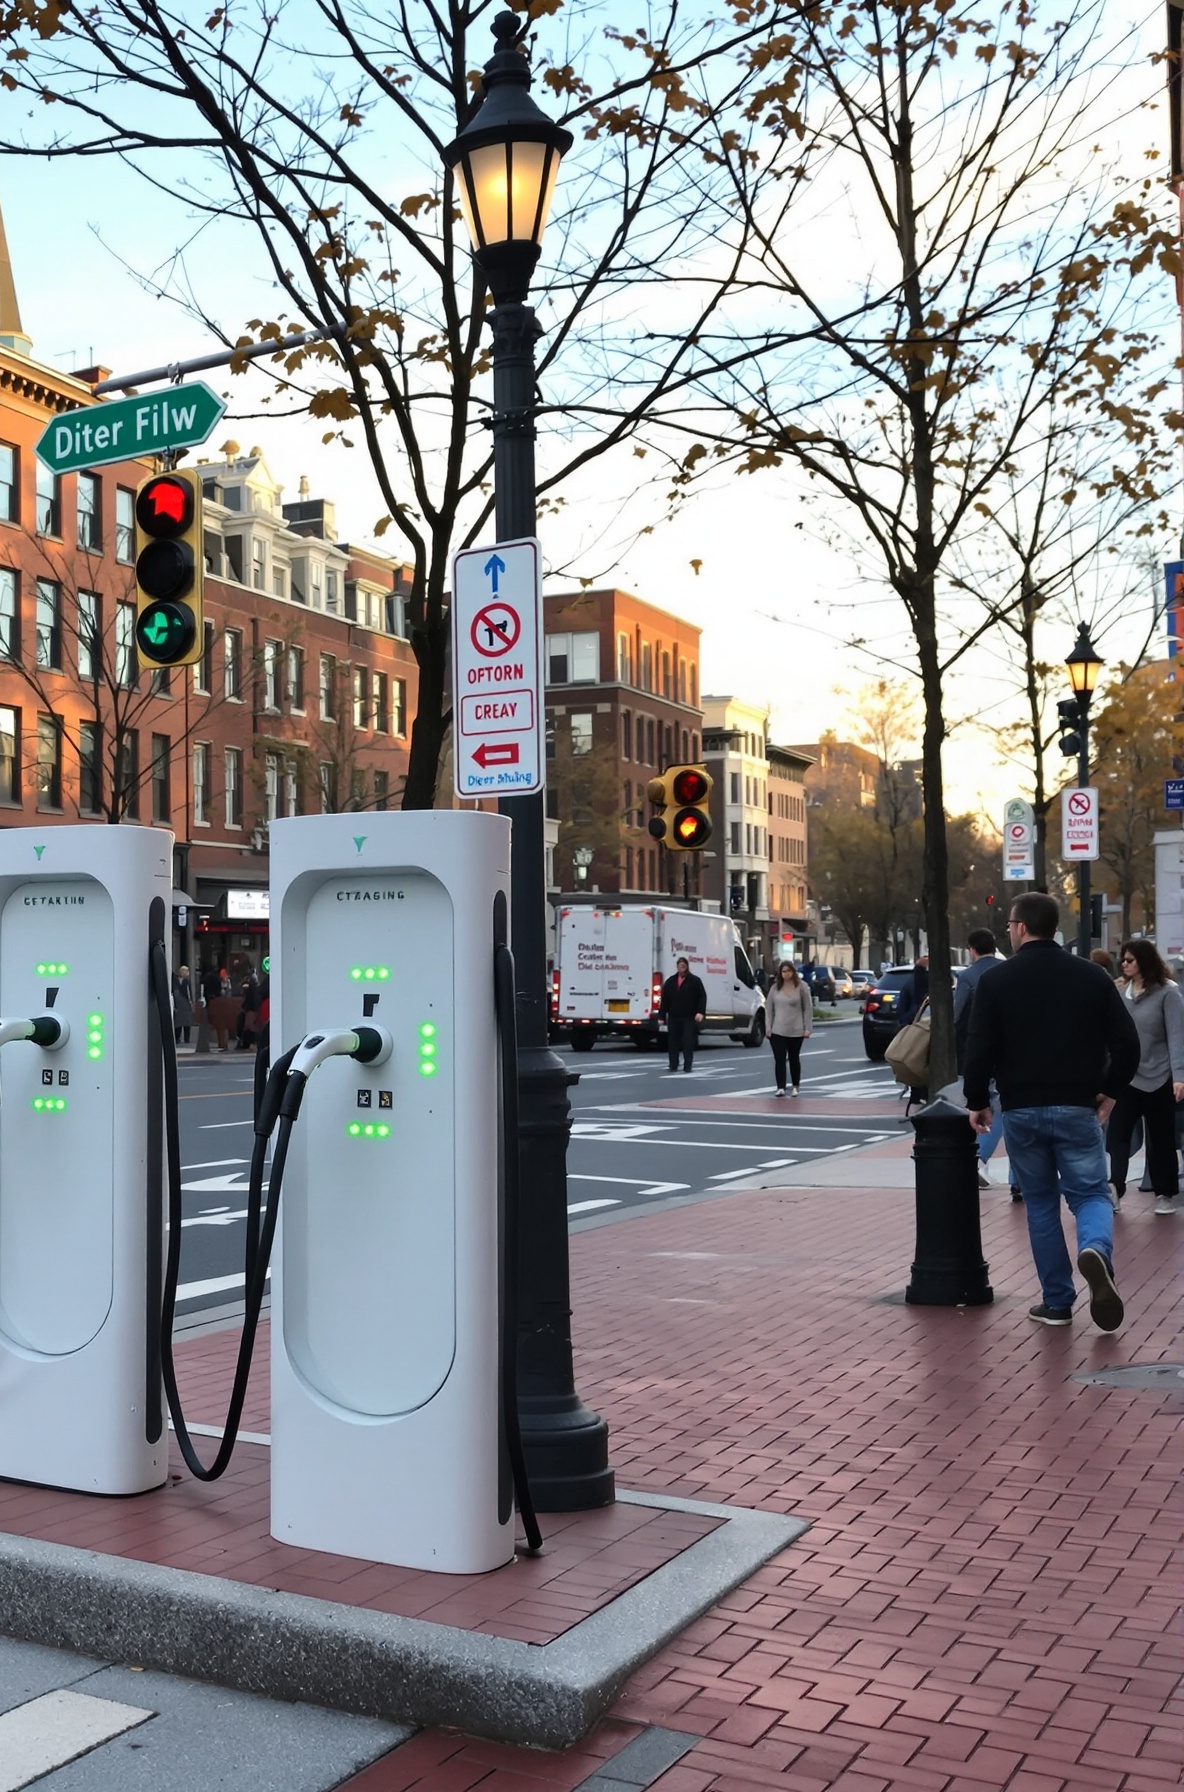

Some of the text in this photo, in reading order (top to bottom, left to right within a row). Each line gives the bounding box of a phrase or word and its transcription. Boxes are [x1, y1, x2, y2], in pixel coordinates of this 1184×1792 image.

[55, 402, 197, 460] Diter Filw
[467, 663, 523, 684] OFTORN
